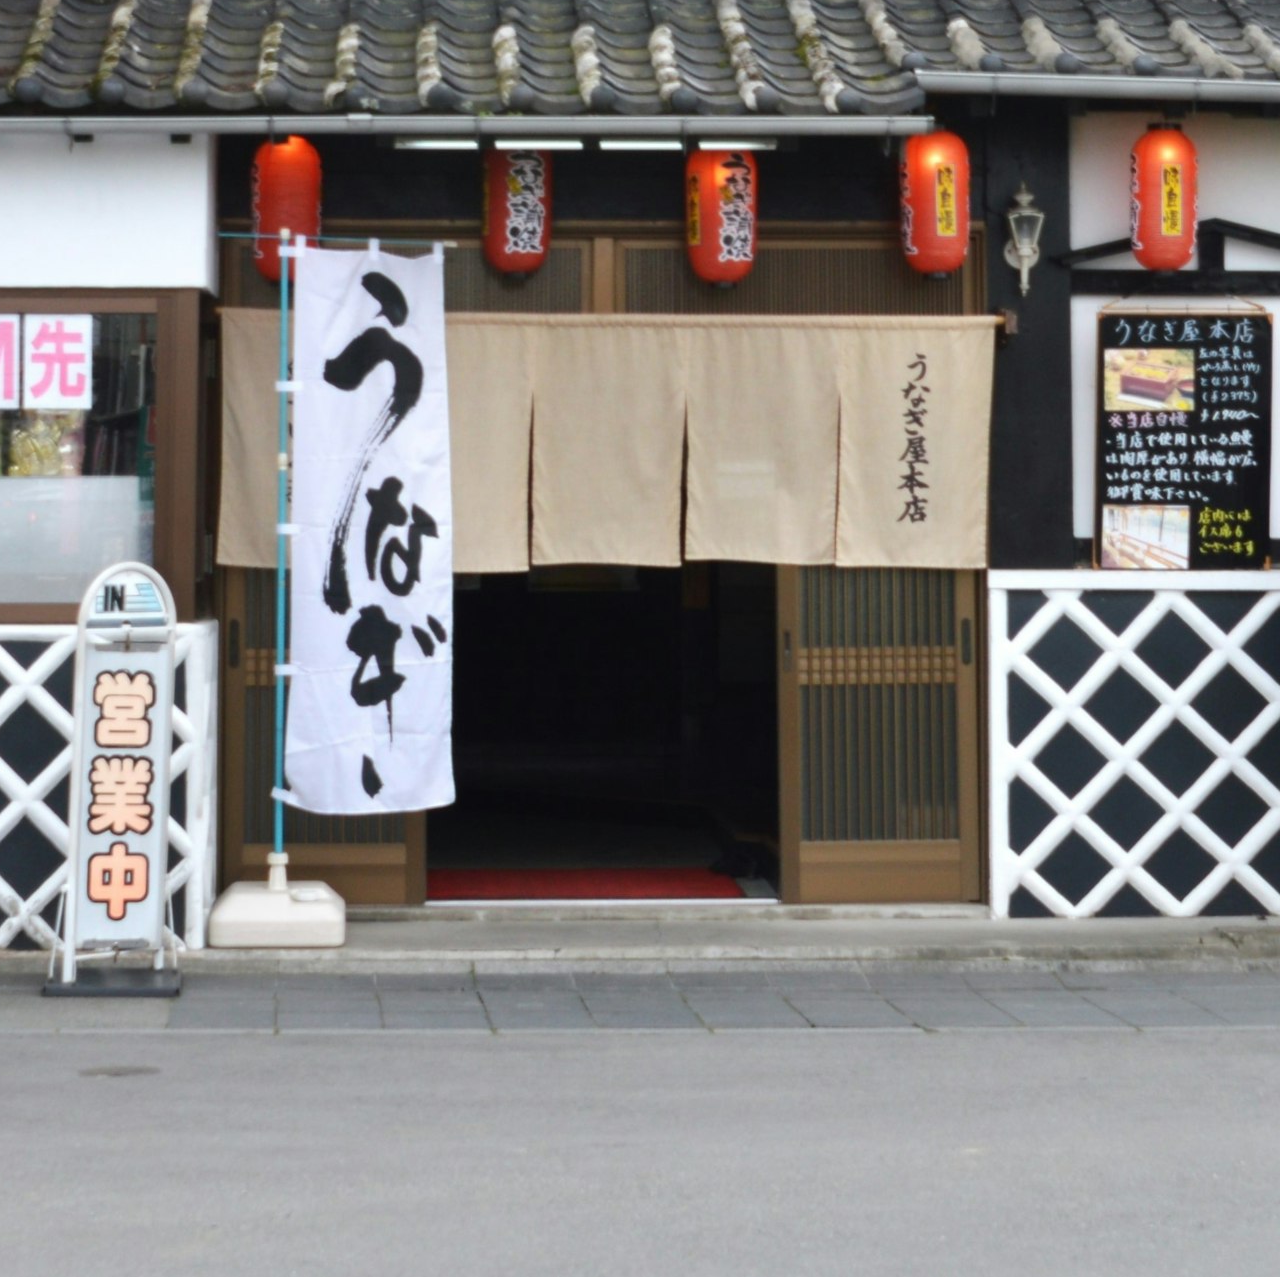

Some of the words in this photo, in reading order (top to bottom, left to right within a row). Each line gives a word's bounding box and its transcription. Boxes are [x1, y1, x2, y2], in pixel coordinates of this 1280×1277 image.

[1115, 318, 1255, 345] うなぎ屋本店
[323, 271, 448, 799] うなぎ
[897, 353, 930, 524] うなぎ屋本店
[86, 670, 156, 922] 営業中
